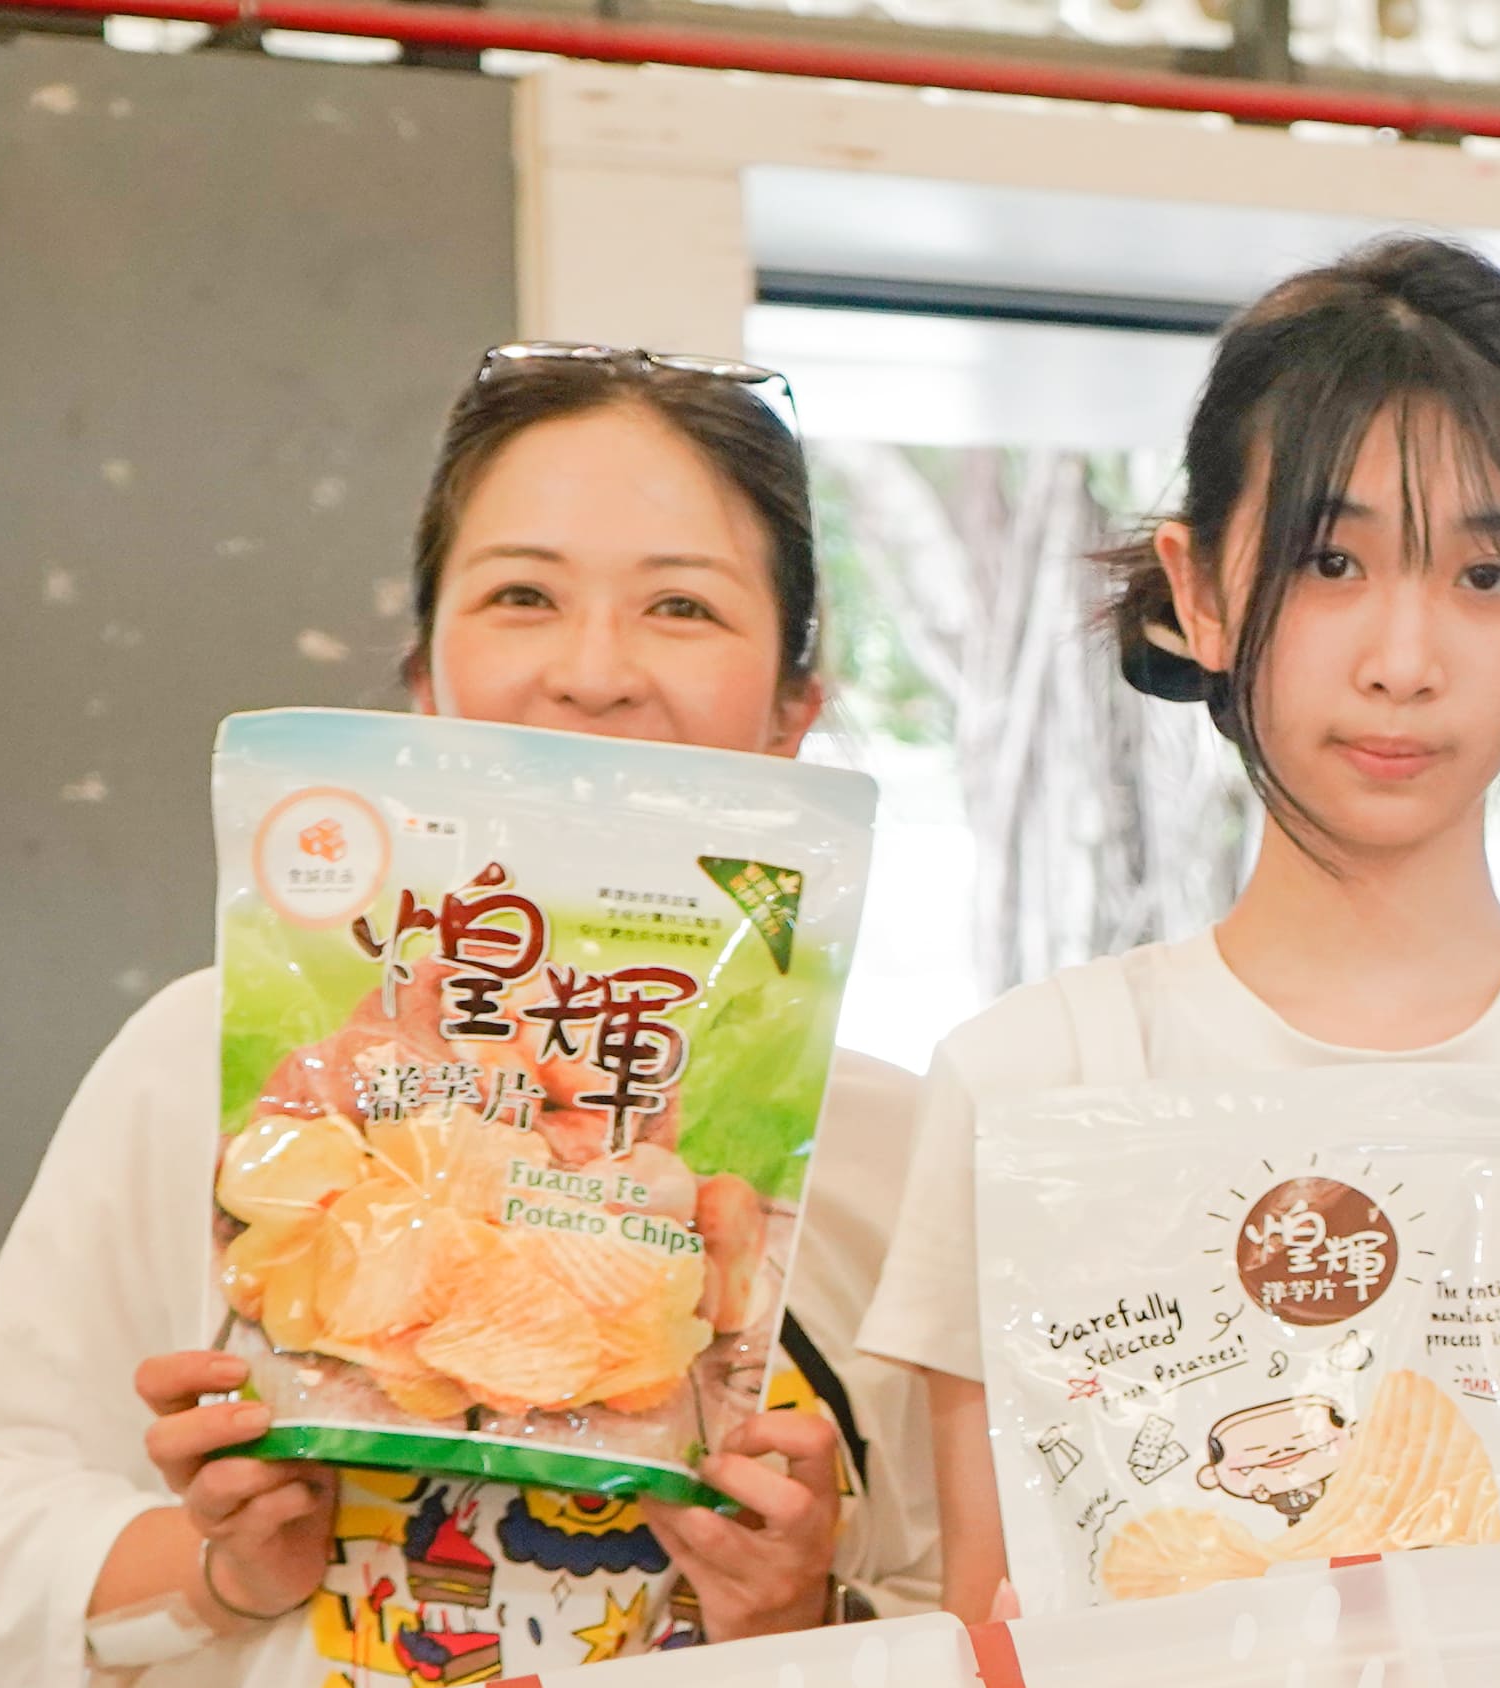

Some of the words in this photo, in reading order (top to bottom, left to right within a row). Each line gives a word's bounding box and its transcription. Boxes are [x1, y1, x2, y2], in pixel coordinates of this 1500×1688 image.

[351, 862, 698, 1156] 煌輝
[365, 1064, 547, 1130] 洋芋片
[509, 1161, 604, 1204] Fuang
[616, 1176, 647, 1204] Fe
[504, 1206, 606, 1236] Potato
[620, 1213, 700, 1255] Chips
[1245, 1201, 1388, 1302] 煌輝
[1436, 1280, 1457, 1299] The
[1049, 1292, 1183, 1350] Carefully
[1426, 1333, 1481, 1356] process
[1084, 1326, 1176, 1370] Selected
